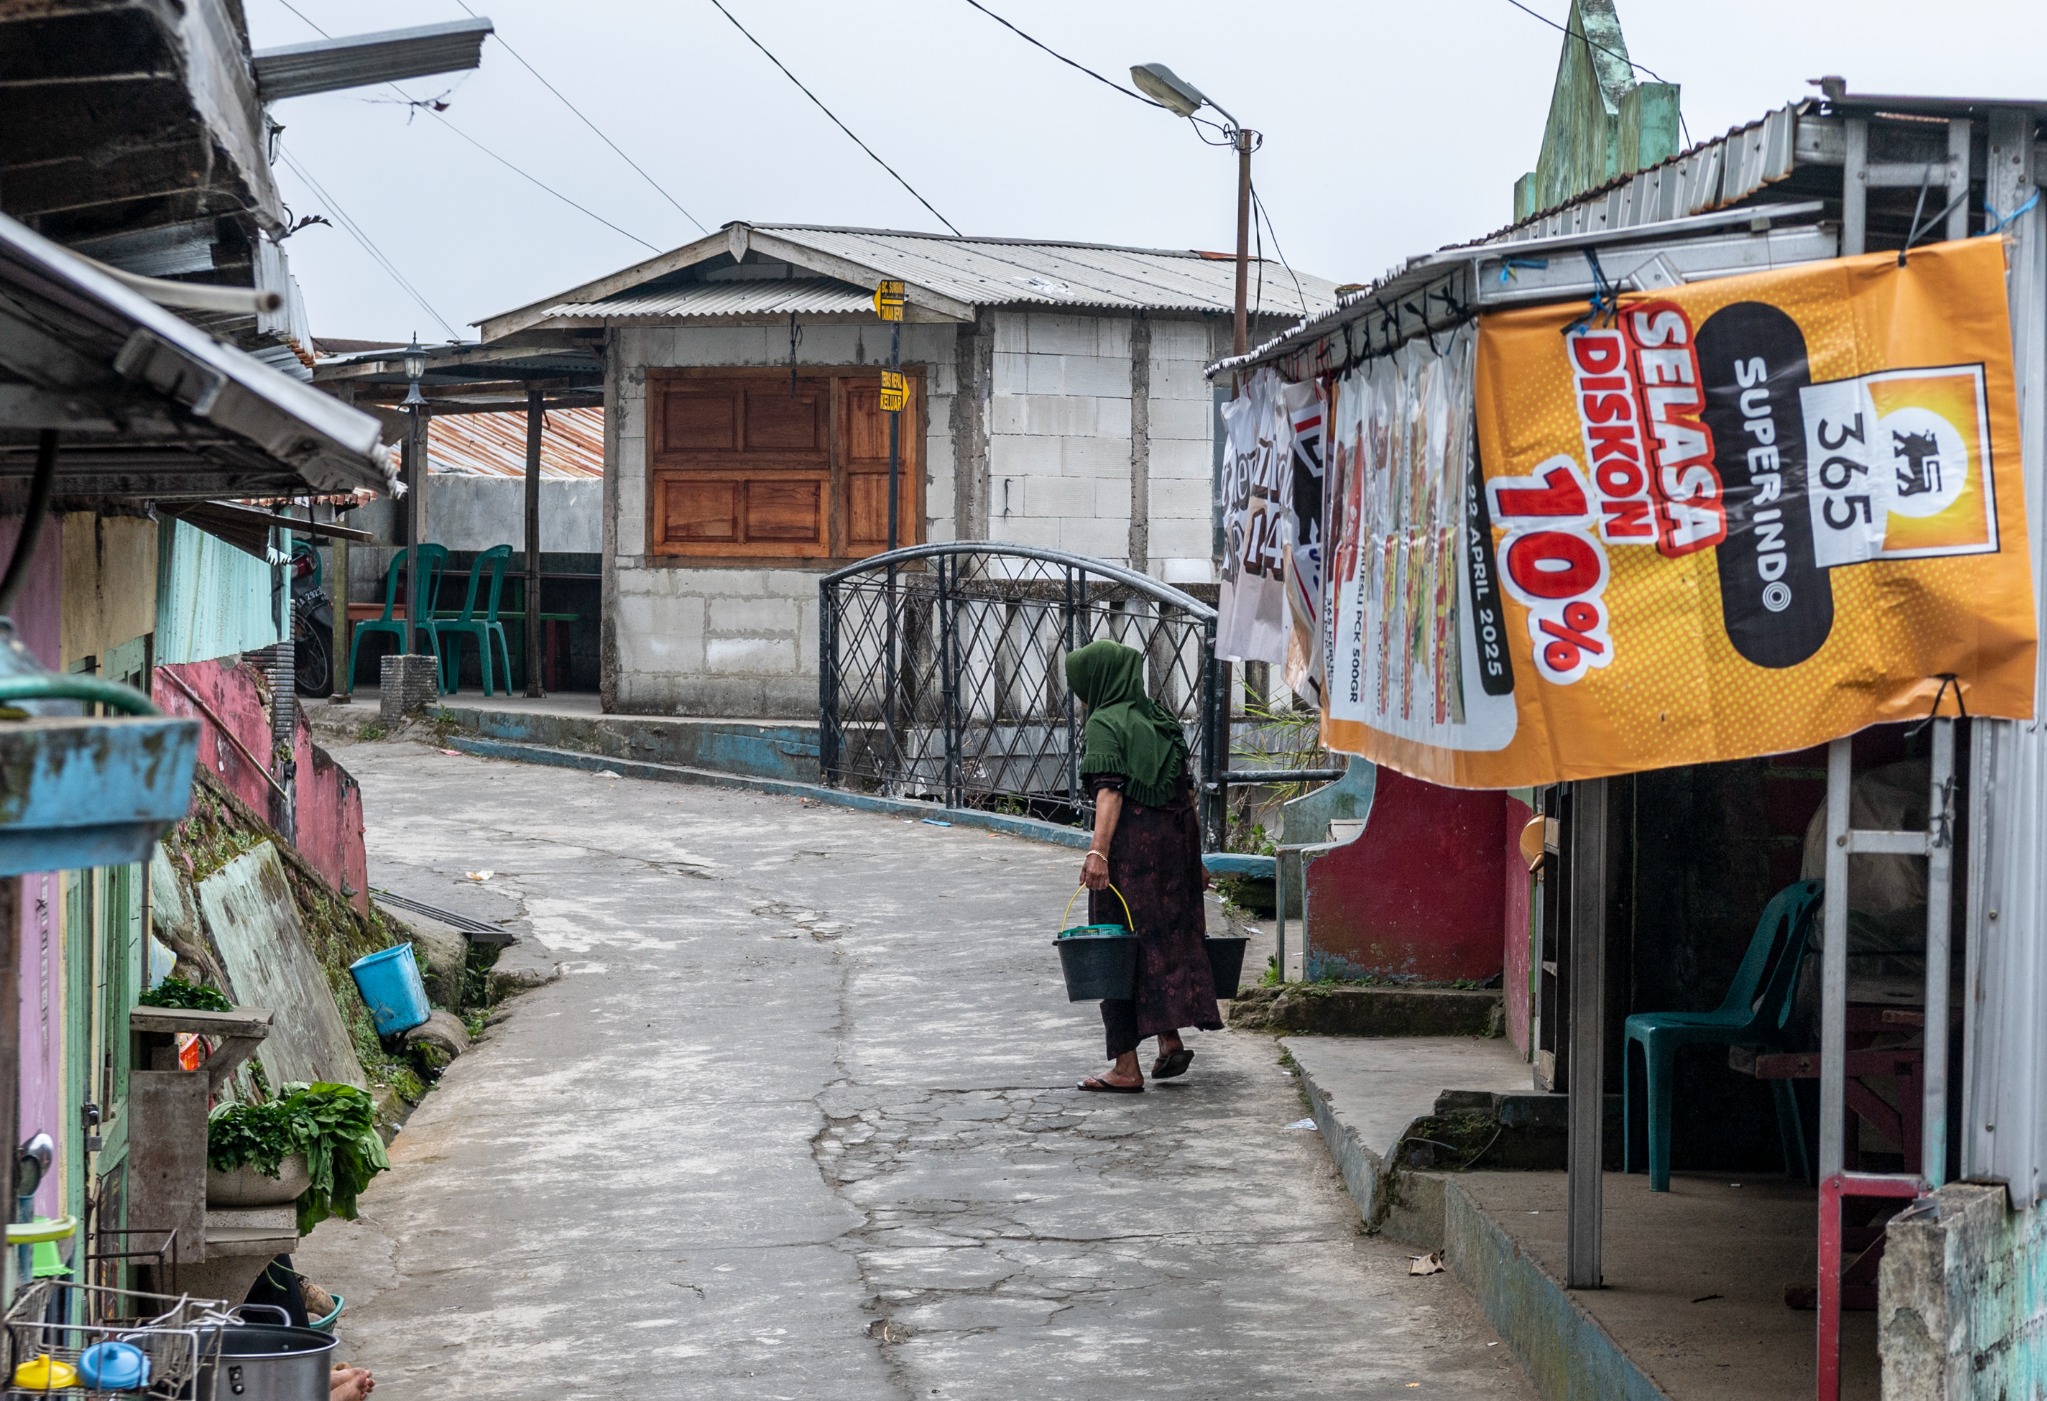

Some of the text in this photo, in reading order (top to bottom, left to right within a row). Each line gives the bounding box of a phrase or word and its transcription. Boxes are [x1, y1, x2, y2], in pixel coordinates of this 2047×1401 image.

[880, 394, 902, 412] KELUAR
[1572, 335, 1654, 539] DISKON
[1630, 309, 1721, 549] SELASA
[1733, 355, 1792, 613] SUPERINDO
[1817, 412, 1873, 531] 365
[1469, 526, 1490, 601] APRIL
[1495, 465, 1606, 673] 10%
[1353, 609, 1363, 643] PCK
[1479, 607, 1503, 678] 2025
[1349, 647, 1360, 704] 500GR
